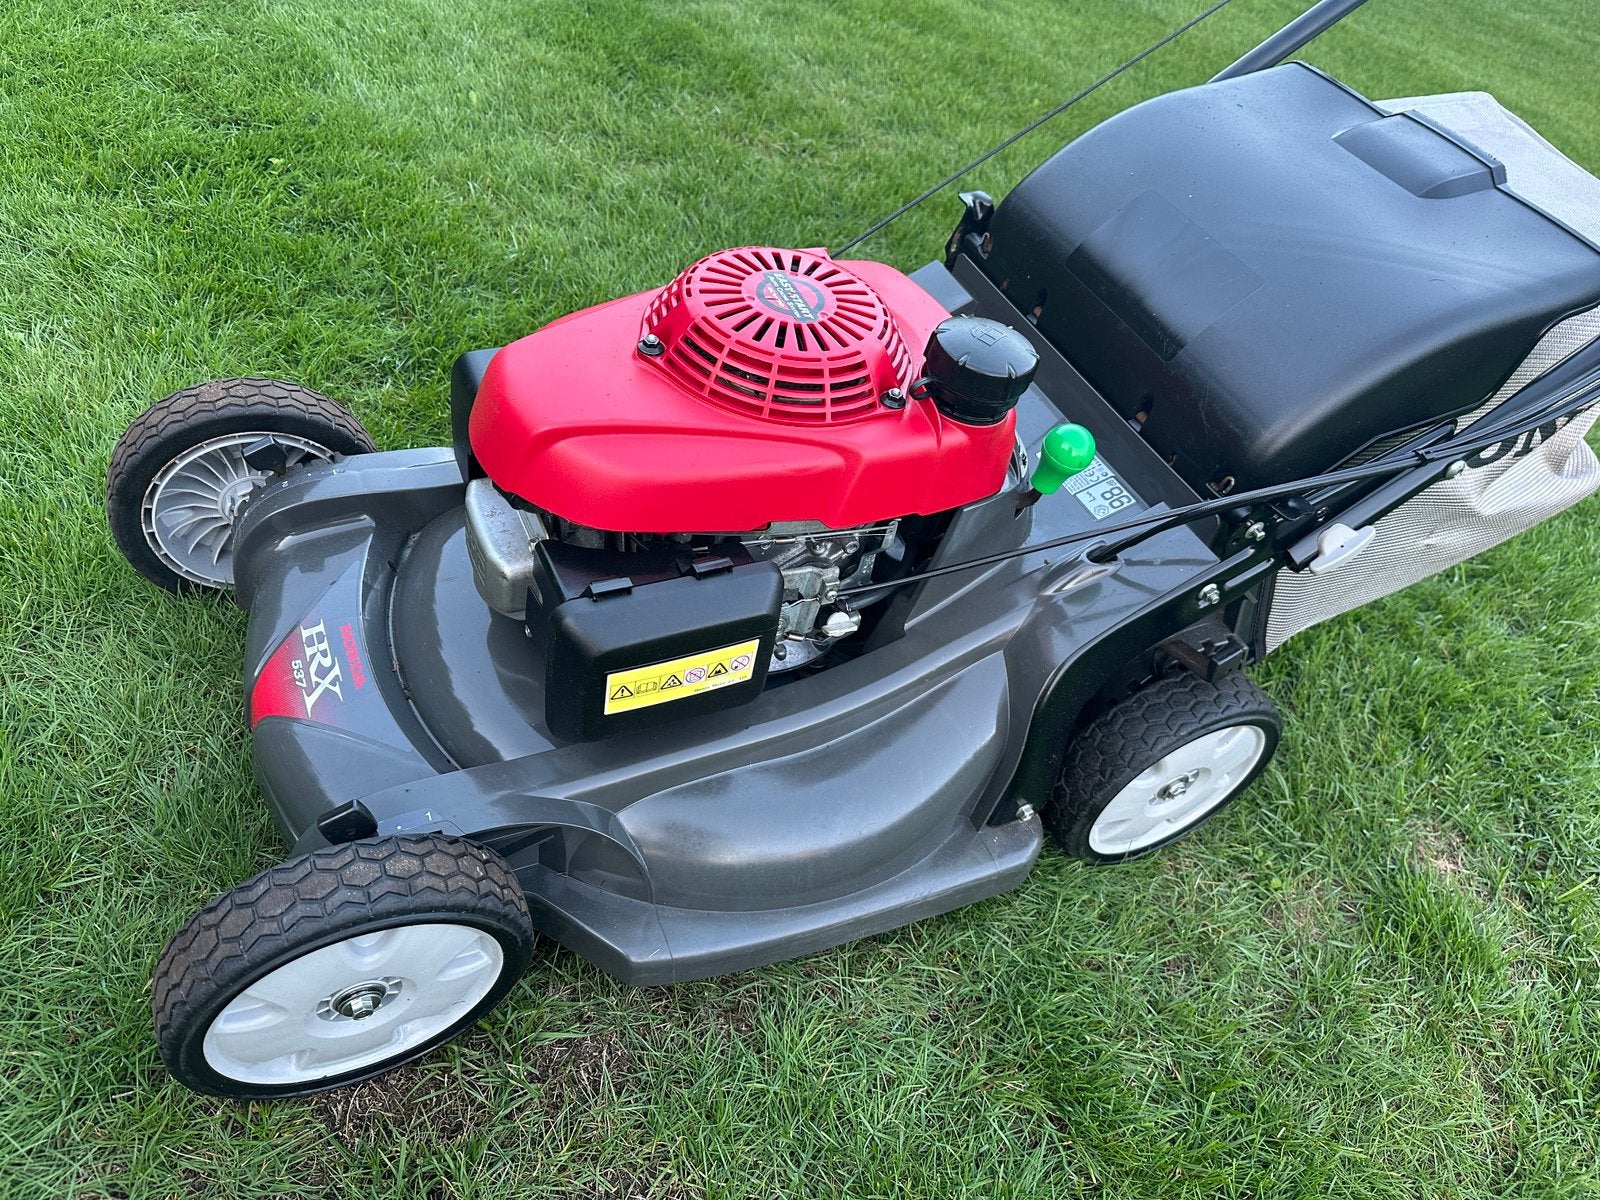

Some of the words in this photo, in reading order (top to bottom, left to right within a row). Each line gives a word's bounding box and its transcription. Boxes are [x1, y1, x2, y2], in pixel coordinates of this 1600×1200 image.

[788, 293, 815, 320] START
[1100, 486, 1132, 510] 98
[300, 617, 344, 718] HRX
[339, 623, 366, 690] HONDA
[291, 659, 307, 688] 537
[425, 811, 432, 821] 1
